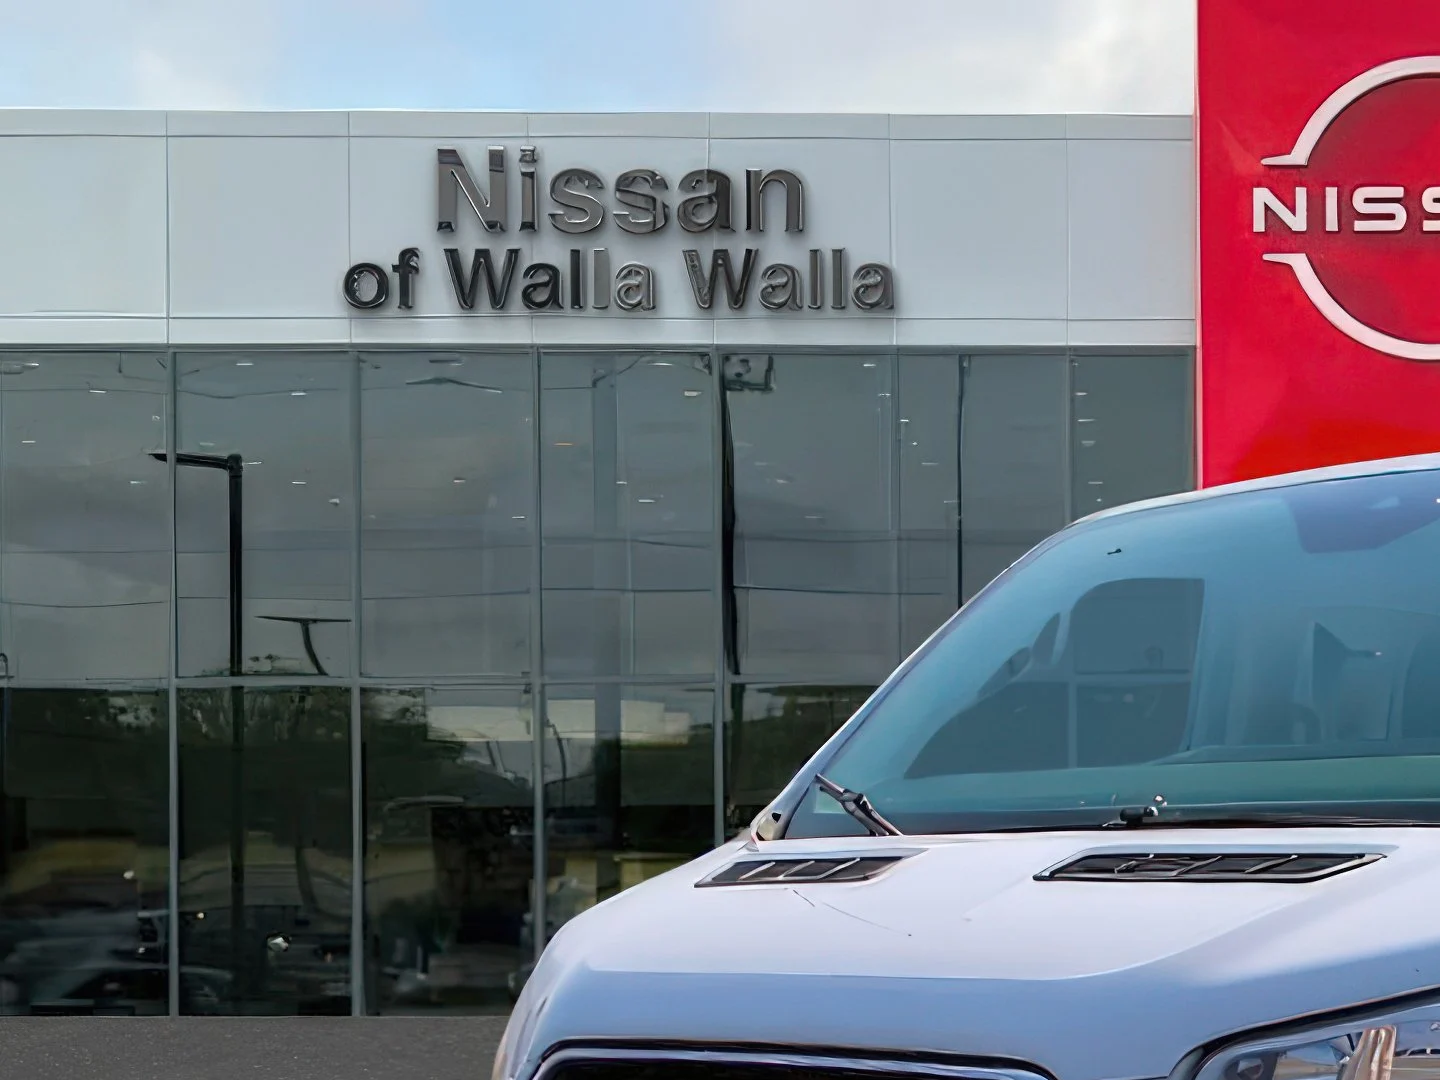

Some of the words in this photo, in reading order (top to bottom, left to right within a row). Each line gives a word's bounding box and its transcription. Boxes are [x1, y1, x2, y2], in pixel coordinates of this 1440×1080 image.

[436, 145, 807, 233] Nissan
[343, 247, 421, 310] of
[444, 248, 656, 310] Walla
[682, 248, 895, 310] Walla
